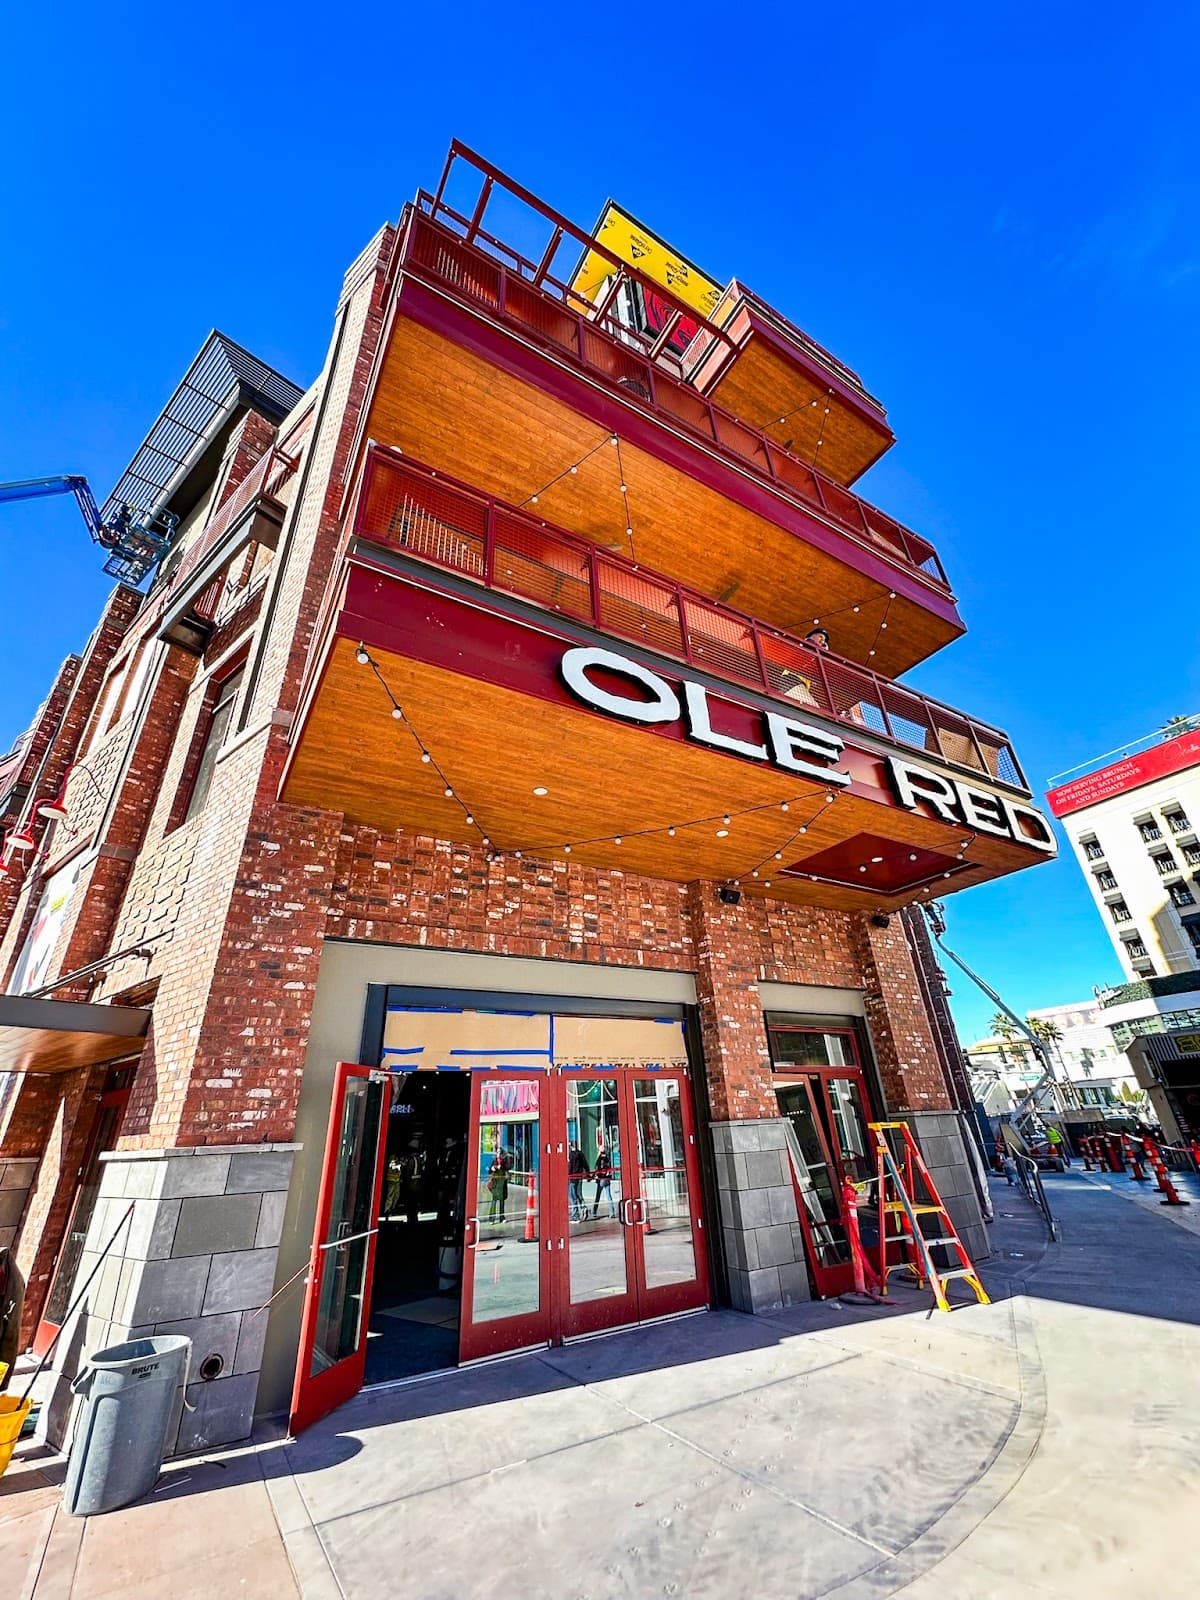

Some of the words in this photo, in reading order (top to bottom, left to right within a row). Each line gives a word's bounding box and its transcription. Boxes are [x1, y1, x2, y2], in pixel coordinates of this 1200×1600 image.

[561, 646, 853, 787] OLE
[887, 755, 1058, 853] RED
[1055, 787, 1072, 797] NOW
[1072, 775, 1103, 790] SERVING
[1102, 762, 1134, 779] BRUNCH
[1055, 797, 1067, 805] ON
[1097, 767, 1141, 788] SATURDAYS
[1075, 795, 1091, 805] AND
[1091, 781, 1125, 798] SUNDAYS
[131, 1362, 160, 1375] BRUTE
